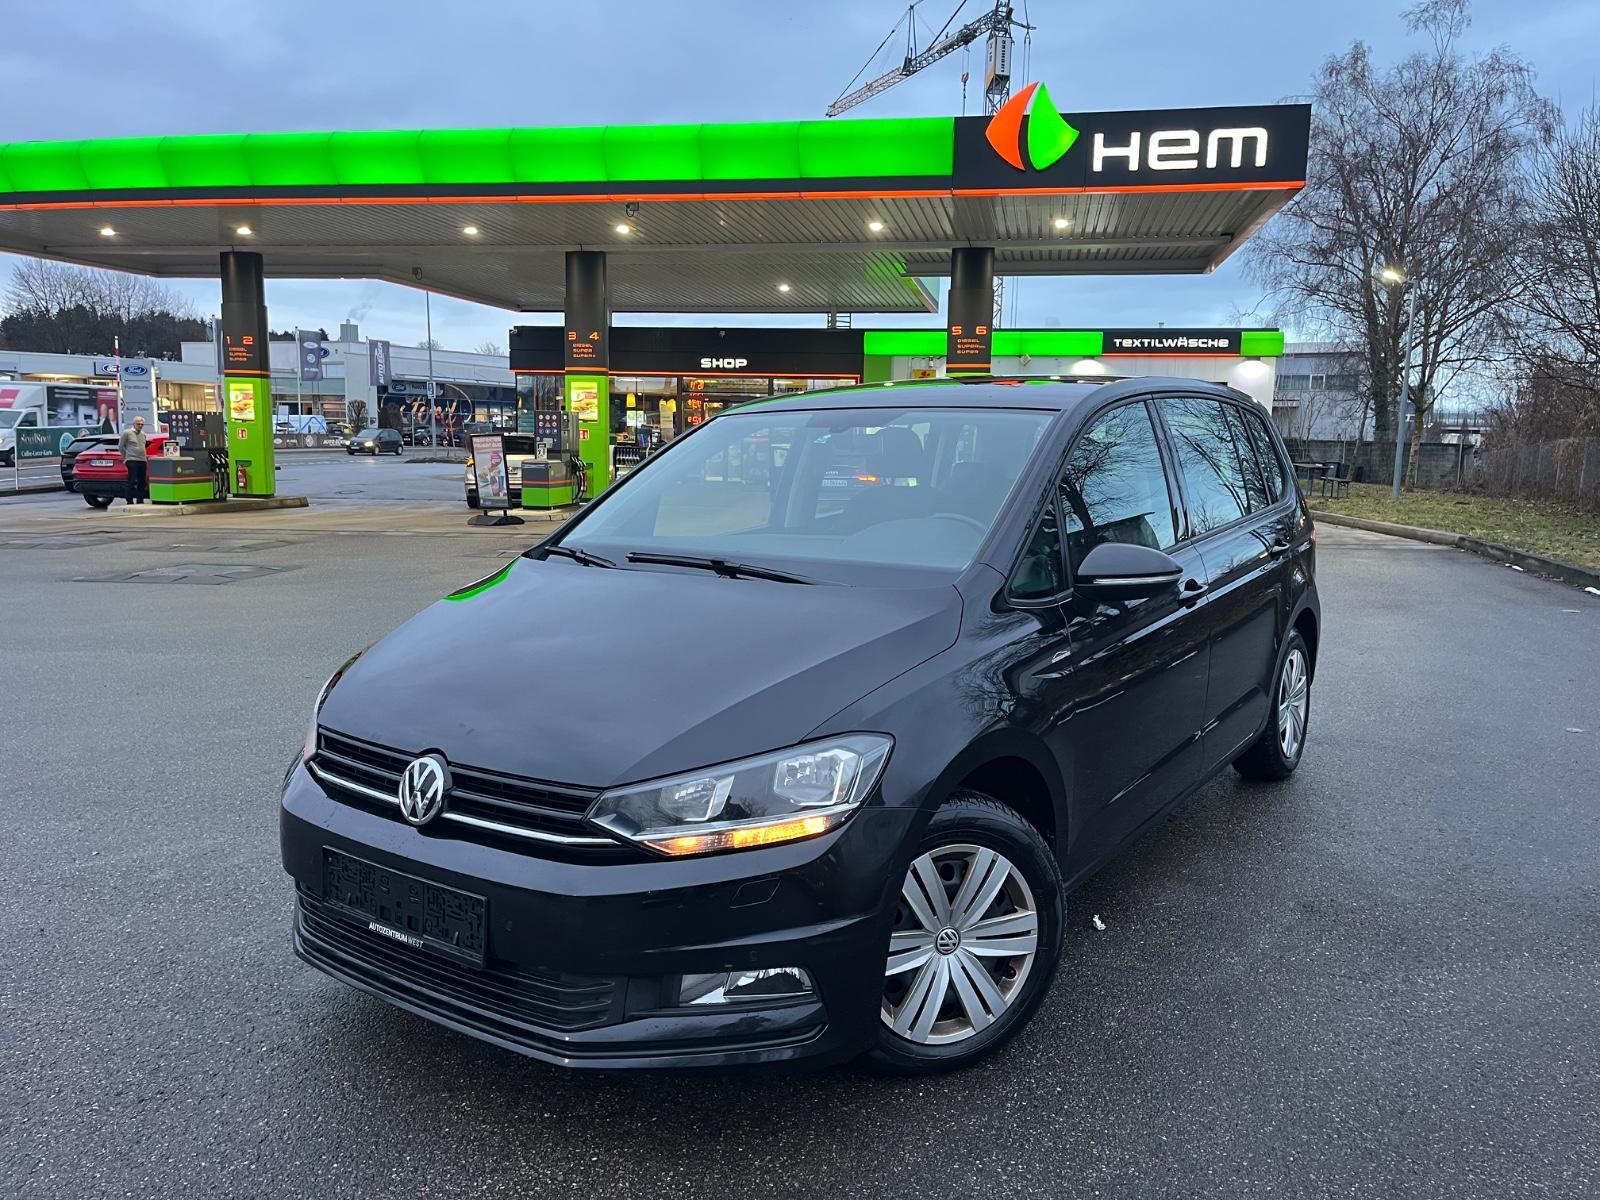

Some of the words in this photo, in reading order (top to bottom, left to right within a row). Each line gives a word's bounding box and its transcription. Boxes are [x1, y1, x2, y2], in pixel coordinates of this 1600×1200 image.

[952, 326, 962, 335] 5
[976, 326, 987, 335] 6
[226, 335, 231, 344] 1
[242, 336, 254, 345] 2
[568, 331, 577, 340] 3
[589, 331, 600, 340] 4
[700, 358, 748, 369] SHOP
[126, 366, 145, 375] Ford
[369, 921, 408, 943] AUTOZENTRUM
[408, 936, 424, 948] WEST
